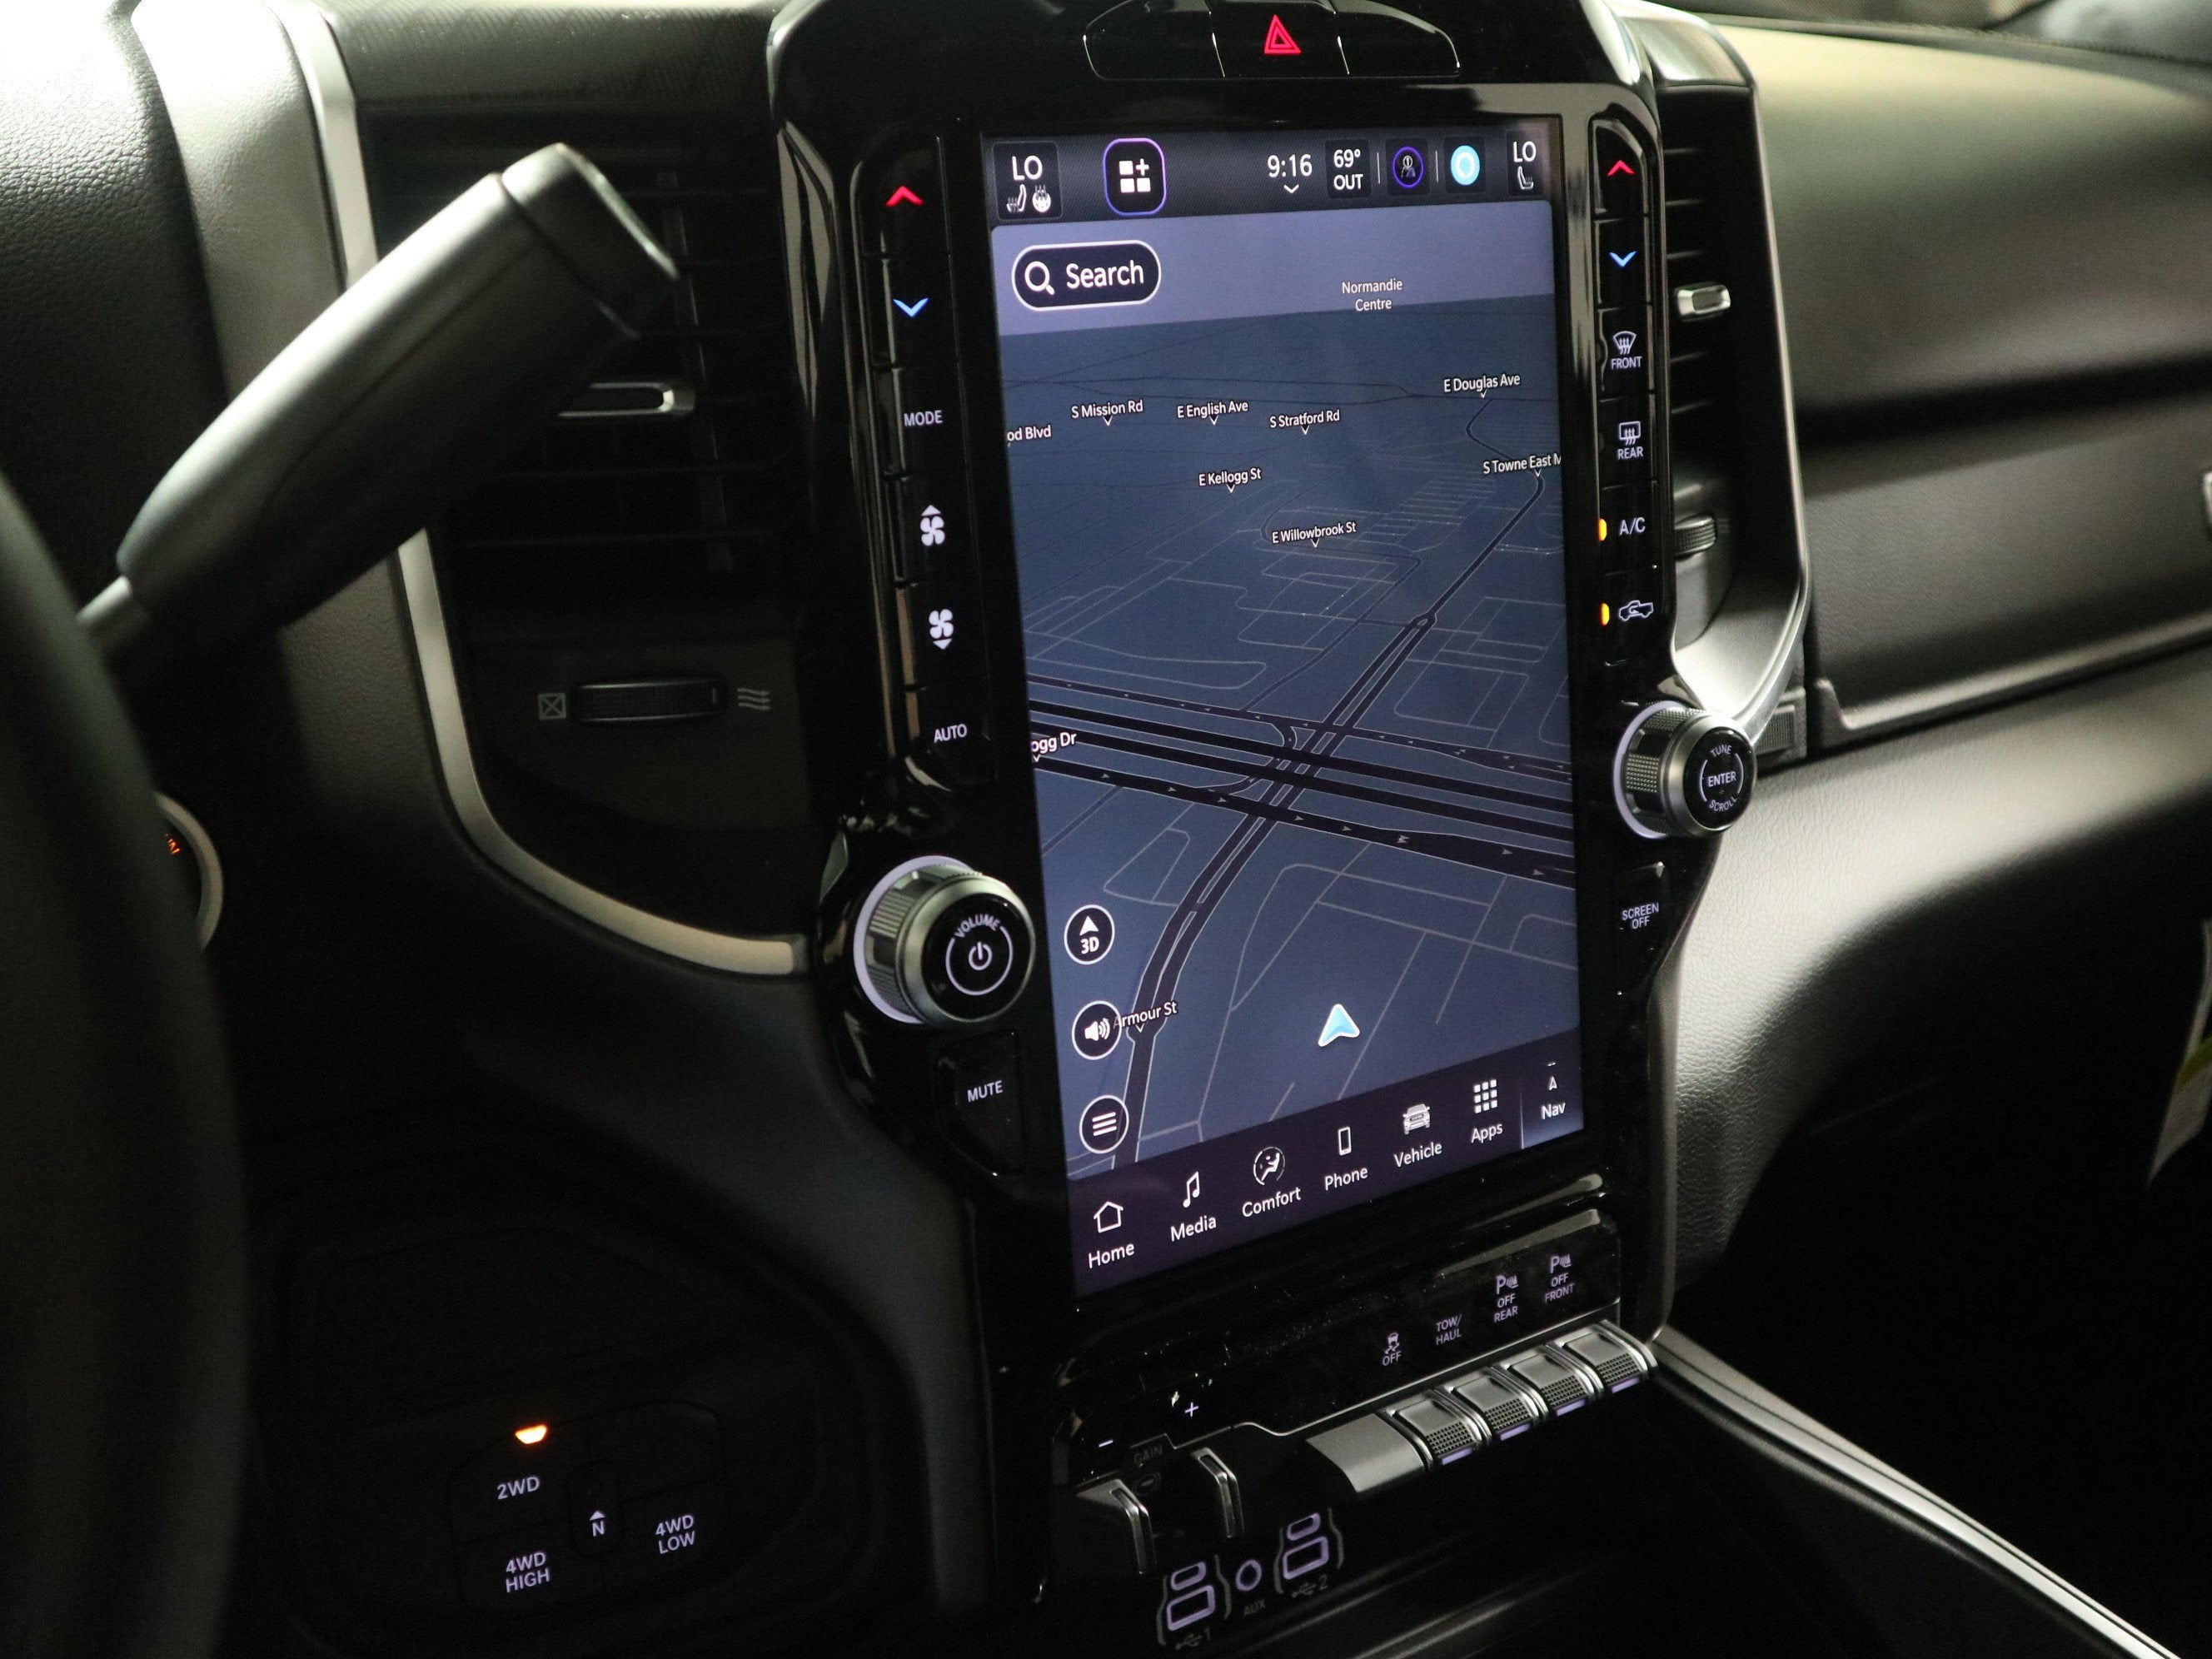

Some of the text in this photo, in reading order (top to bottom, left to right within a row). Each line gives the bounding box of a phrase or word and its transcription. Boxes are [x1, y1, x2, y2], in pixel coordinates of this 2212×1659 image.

[1333, 148, 1362, 169] 69°
[1512, 140, 1537, 163] LO
[1014, 155, 1044, 182] LO
[1267, 153, 1313, 178] 9:16
[1333, 173, 1364, 191] OUT
[1065, 259, 1144, 290] Search
[1341, 278, 1403, 296] Normandie
[1354, 296, 1392, 312] Centre
[1611, 356, 1643, 371] FRONT
[1443, 373, 1522, 393] E Douglas Ave
[904, 409, 944, 427] MODE
[1071, 399, 1144, 419] S Mission Rd
[1177, 401, 1249, 419] E English Ave
[1269, 409, 1340, 429] S Stratford Rd
[1024, 424, 1052, 440] Blvd
[1617, 446, 1644, 461] REAR
[1483, 461, 1491, 475] S
[1492, 459, 1527, 473] Towne
[1529, 455, 1552, 469] East
[1198, 467, 1262, 487] E Kellogg St
[1272, 521, 1357, 544] E Willowbrook St
[1619, 516, 1647, 536] A/C
[934, 723, 968, 744] AUTO
[1059, 731, 1077, 747] Dr
[1711, 744, 1733, 757] TUNE
[1707, 770, 1737, 788] ENTER
[1709, 795, 1738, 812] SCROLL
[1622, 902, 1660, 921] SCREEN
[954, 913, 1001, 939] VOLUME
[1632, 915, 1651, 929] OFF
[1079, 936, 1101, 955] 3D
[1163, 1001, 1178, 1016] St
[967, 1079, 1004, 1103] MUTE
[1541, 1101, 1567, 1120] Nav
[1470, 1122, 1504, 1144] Apps
[1394, 1141, 1442, 1168] Vehicle
[1324, 1166, 1368, 1191] Phone
[1242, 1185, 1302, 1218] Comfort
[1170, 1213, 1217, 1242] Media
[1088, 1242, 1135, 1269] Home
[1551, 1273, 1569, 1288] OFF
[1497, 1293, 1516, 1308] OFF
[1544, 1283, 1574, 1303] FRONT
[1436, 1313, 1462, 1333] TOW/
[1493, 1306, 1518, 1323] REAR
[1435, 1329, 1462, 1346] HAUL
[1382, 1351, 1402, 1367] OFF
[496, 1476, 541, 1501] 2WD
[591, 1521, 606, 1537] N
[655, 1514, 695, 1537] 4WD
[657, 1530, 696, 1555] LOW
[506, 1550, 547, 1574] 4WD
[505, 1567, 551, 1594] HIGH
